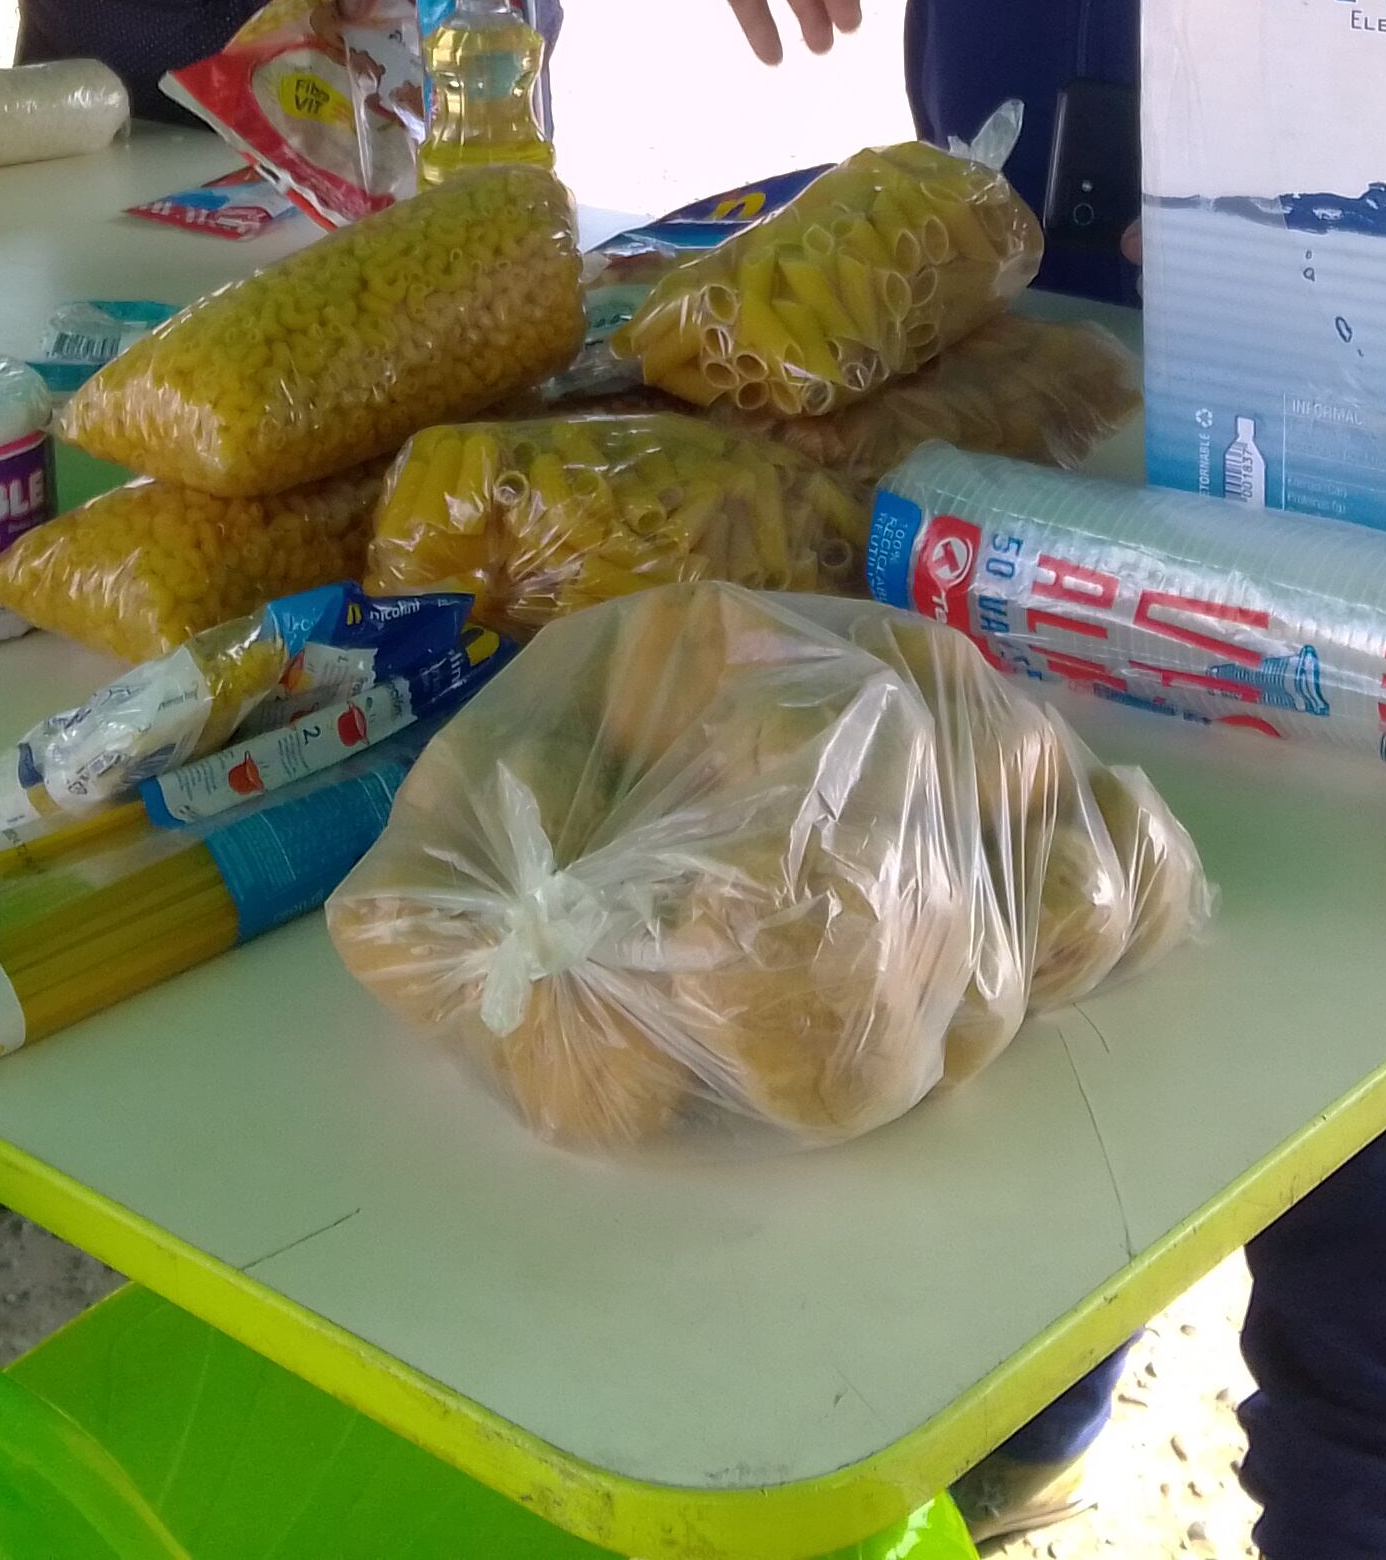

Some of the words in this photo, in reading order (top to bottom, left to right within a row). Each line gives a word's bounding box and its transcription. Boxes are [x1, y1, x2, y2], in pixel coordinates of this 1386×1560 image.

[1292, 398, 1363, 427] INFORMAC
[1197, 432, 1211, 496] ETORNABLE
[985, 533, 1025, 580] 50
[370, 600, 421, 621] nicolini
